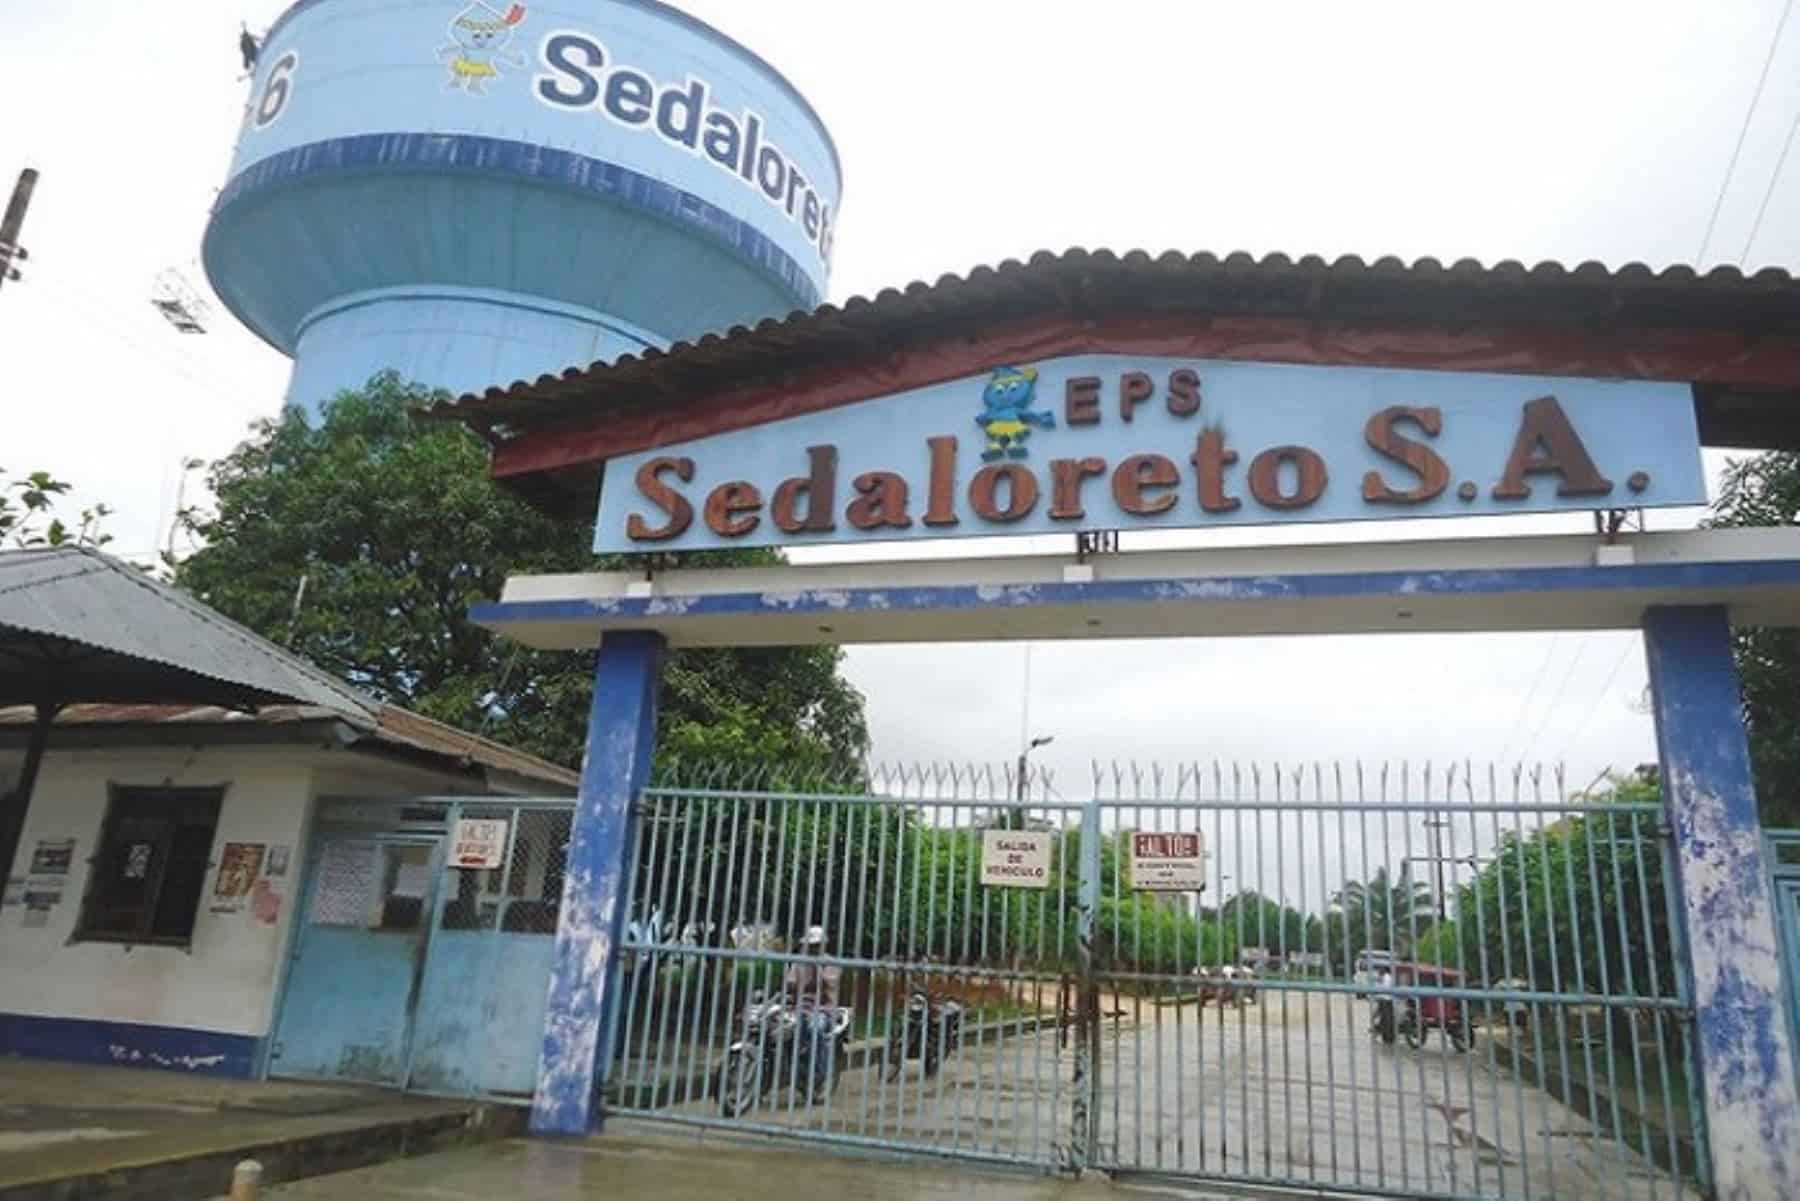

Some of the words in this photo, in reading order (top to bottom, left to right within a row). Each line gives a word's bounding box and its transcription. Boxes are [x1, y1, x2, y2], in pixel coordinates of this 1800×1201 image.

[539, 34, 833, 260] Sedaloret
[1065, 368, 1202, 425] EPS
[627, 424, 1329, 542] Sedaloreto
[1361, 395, 1651, 506] S.A.
[996, 840, 1037, 851] SALIDA
[1008, 853, 1023, 864] DE
